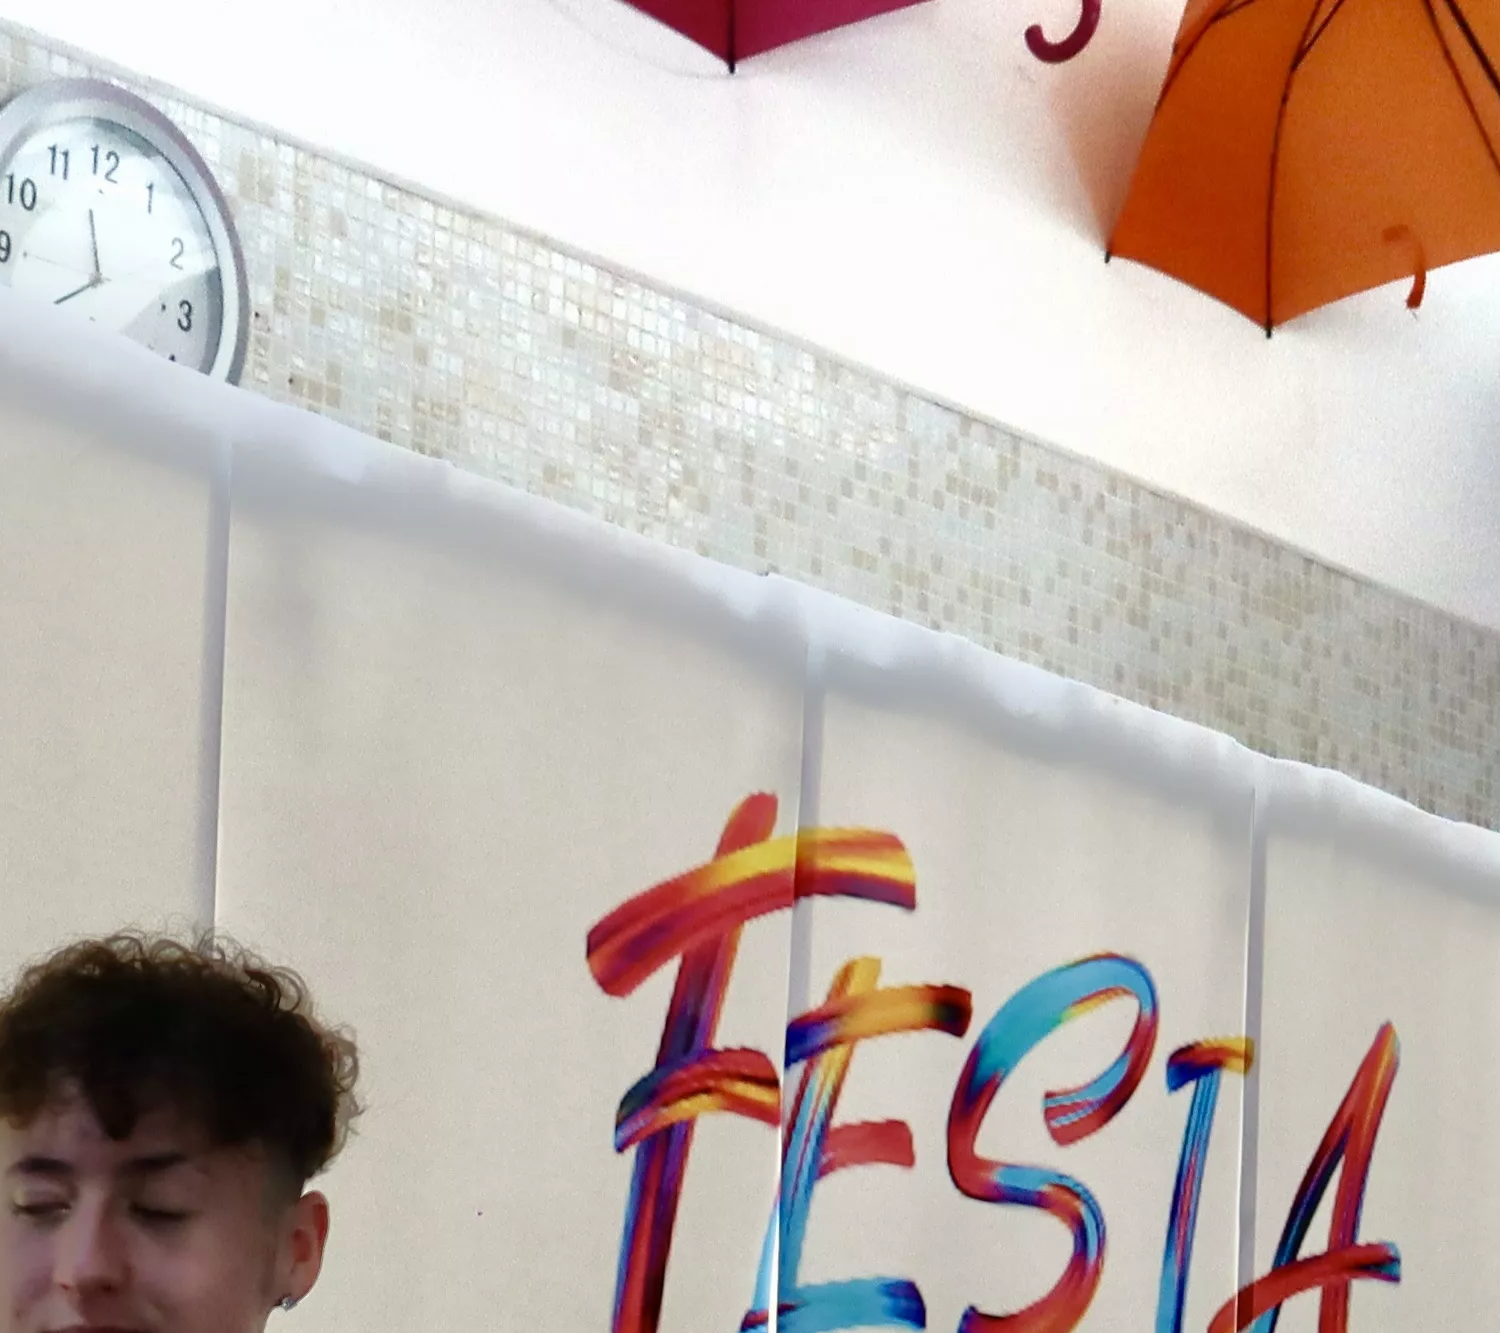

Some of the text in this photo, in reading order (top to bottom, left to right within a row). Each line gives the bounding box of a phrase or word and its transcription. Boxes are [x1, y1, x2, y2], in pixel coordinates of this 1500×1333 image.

[48, 145, 70, 180] 11
[90, 144, 120, 184] 12
[6, 174, 37, 211] 10
[146, 183, 154, 213] 1
[170, 237, 184, 270] 2
[177, 301, 192, 331] 3
